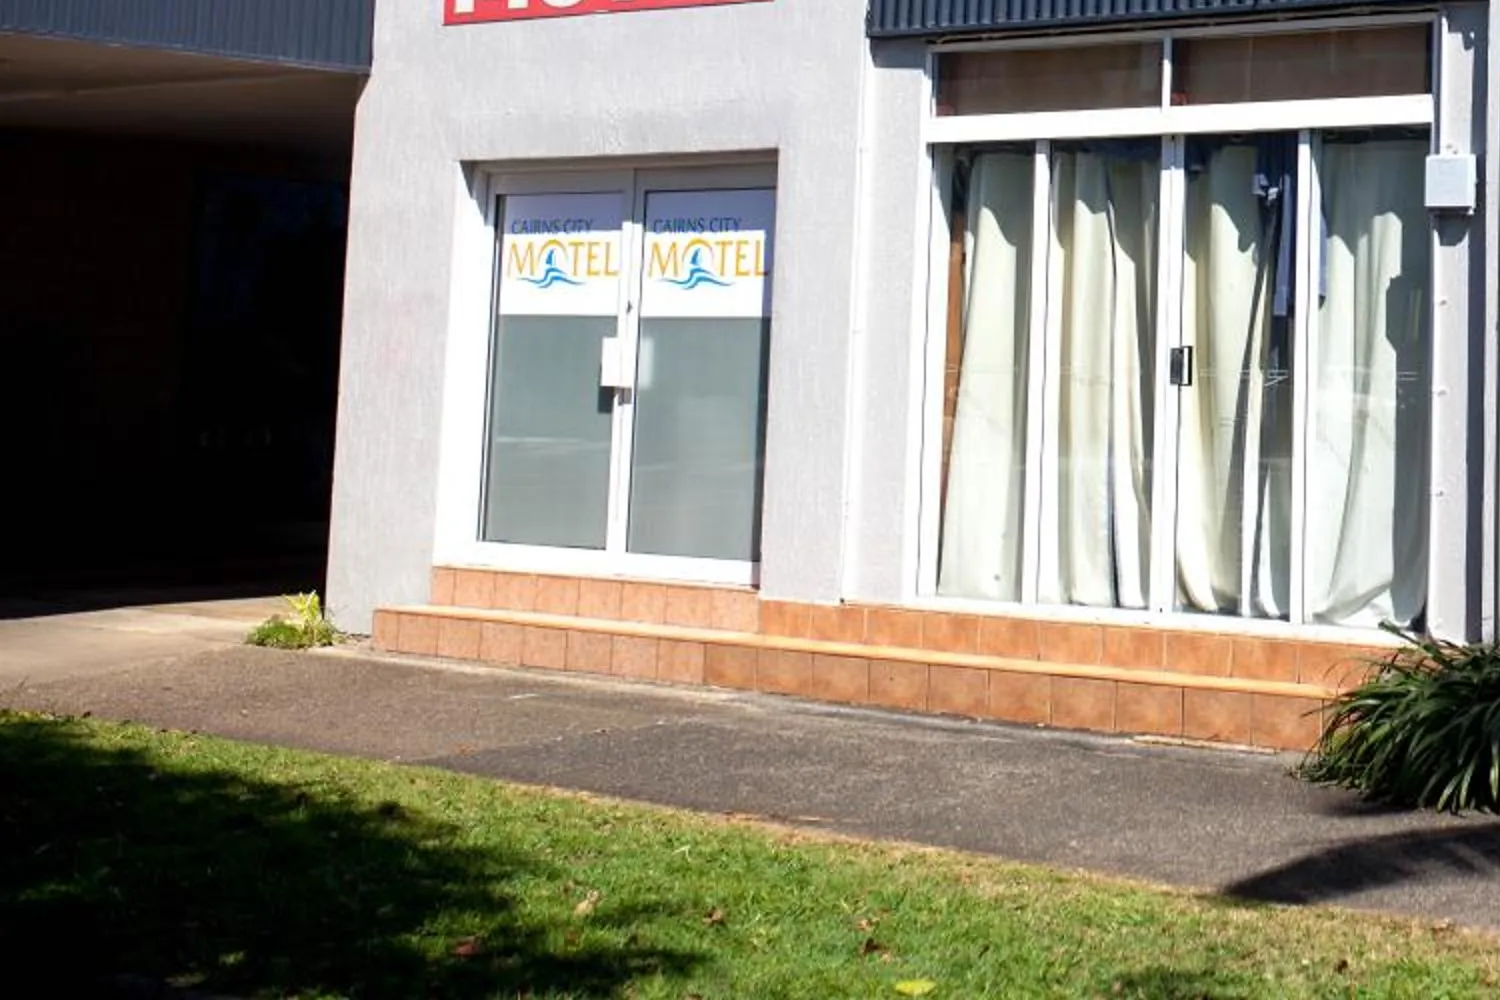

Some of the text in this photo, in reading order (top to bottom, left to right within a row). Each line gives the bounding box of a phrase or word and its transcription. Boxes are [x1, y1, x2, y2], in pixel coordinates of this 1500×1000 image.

[511, 217, 593, 235] CAIRNS CITY
[653, 216, 742, 234] CAIRNS CITY
[506, 239, 619, 277] MOTEL
[648, 237, 769, 277] MOTEL
